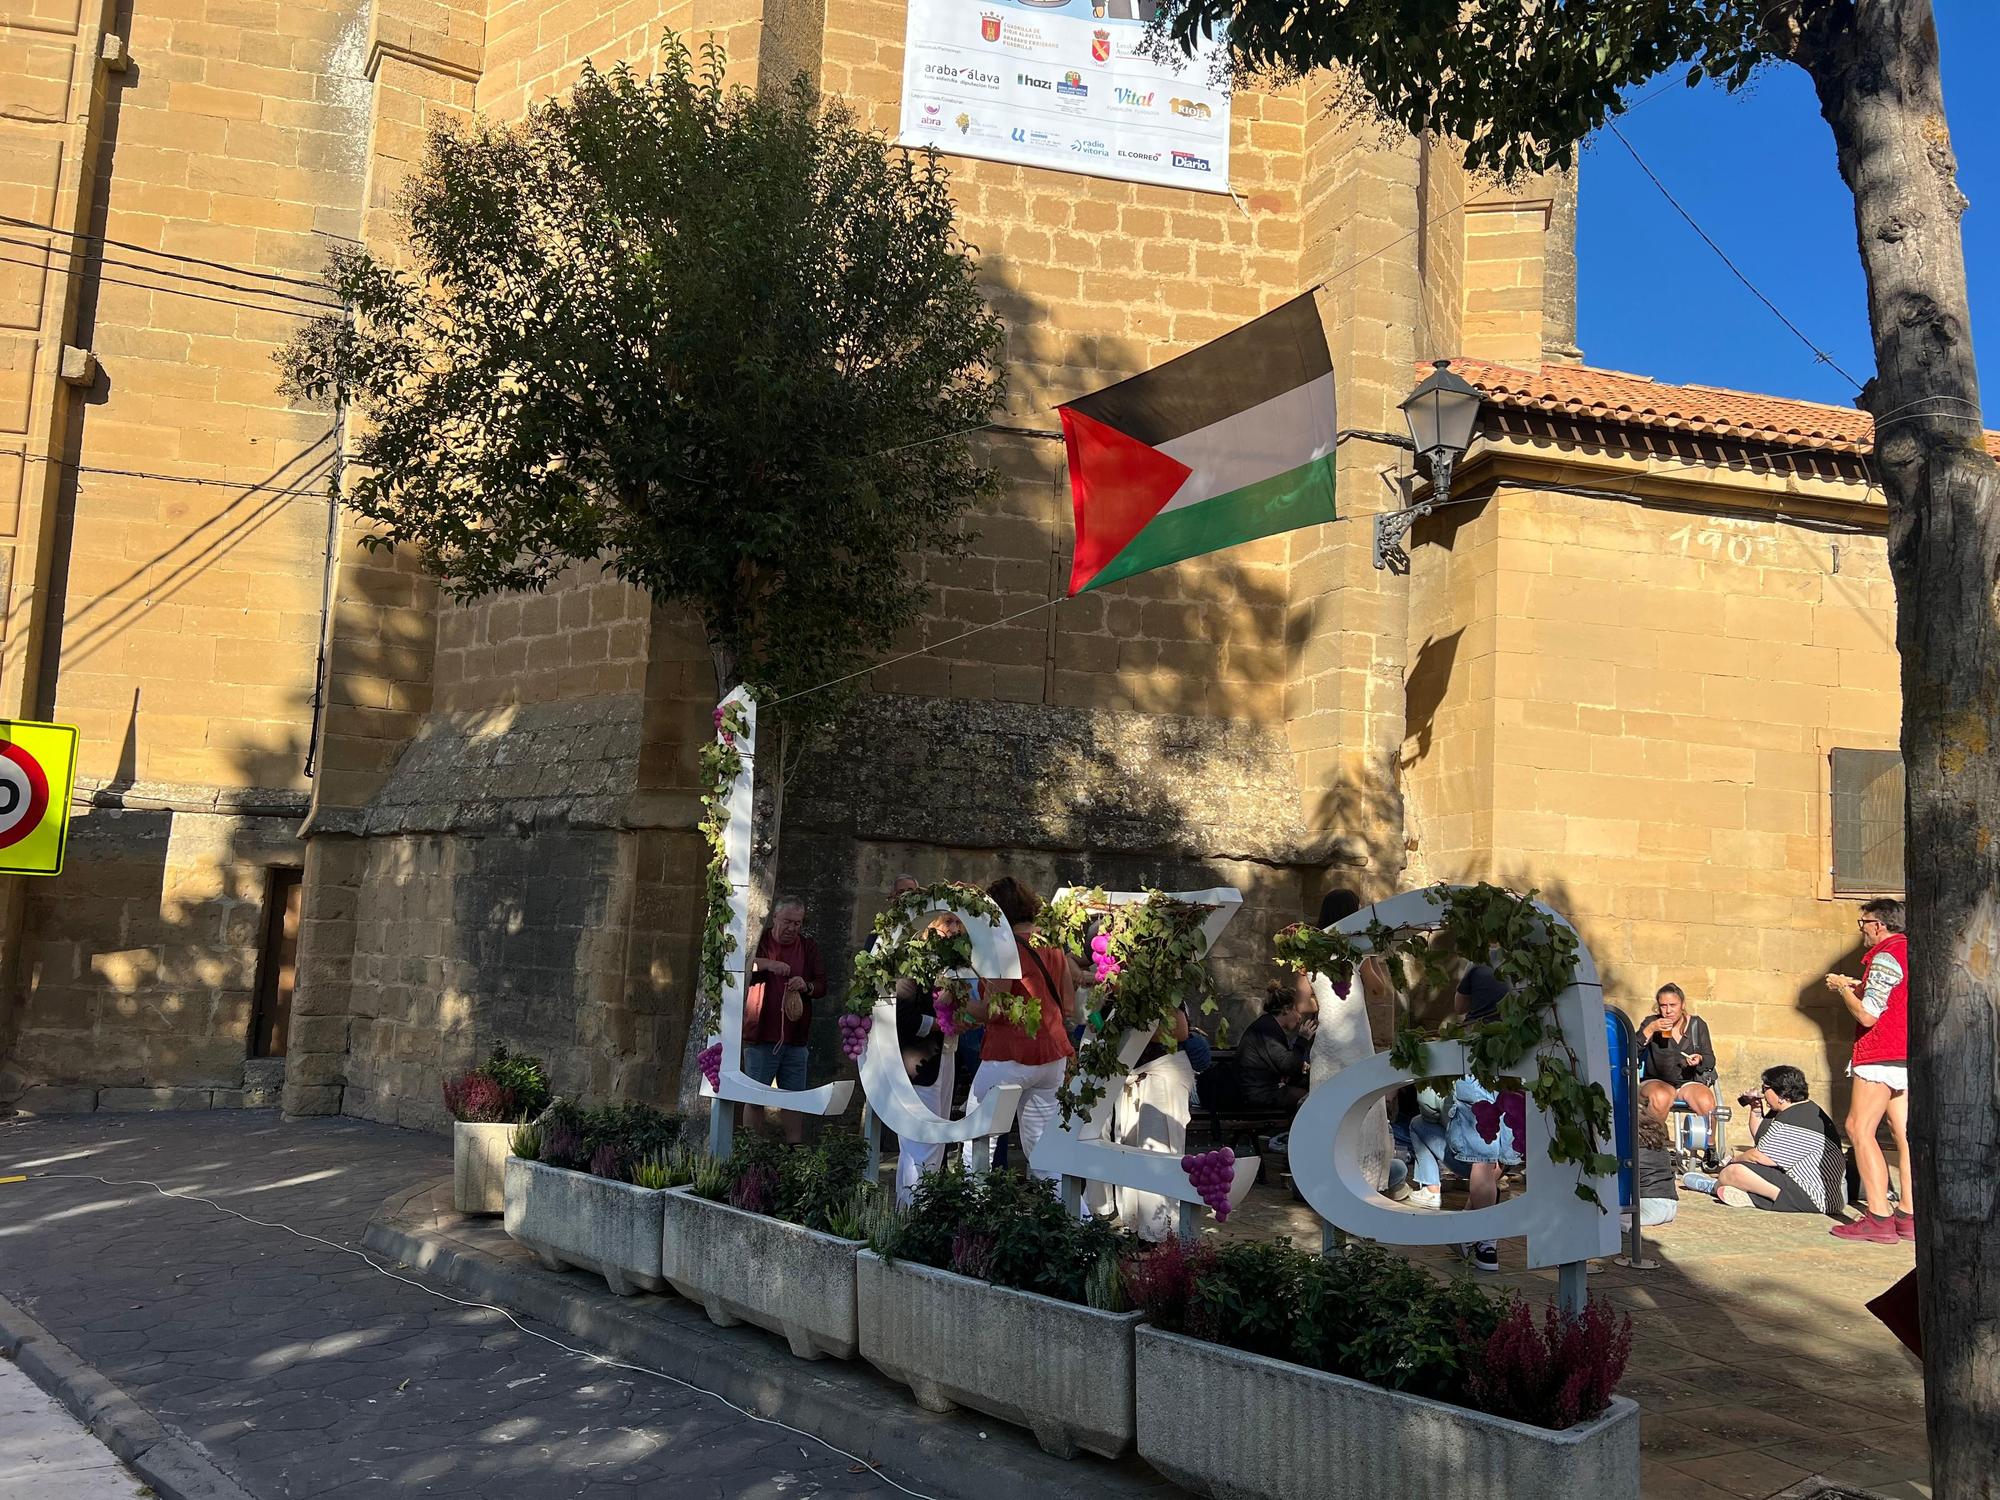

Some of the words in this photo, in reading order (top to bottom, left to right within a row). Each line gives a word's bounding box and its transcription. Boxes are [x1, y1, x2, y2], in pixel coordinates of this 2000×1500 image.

[924, 63, 958, 77] araba
[967, 69, 1000, 84] álava
[1025, 74, 1052, 90] hazi
[1114, 87, 1155, 107] Vital
[921, 116, 941, 126] abra
[1082, 139, 1105, 149] radio
[1082, 147, 1109, 158] vitoria
[1118, 150, 1128, 158] EL
[1128, 152, 1159, 162] CORREO
[1175, 157, 1208, 170] Diario
